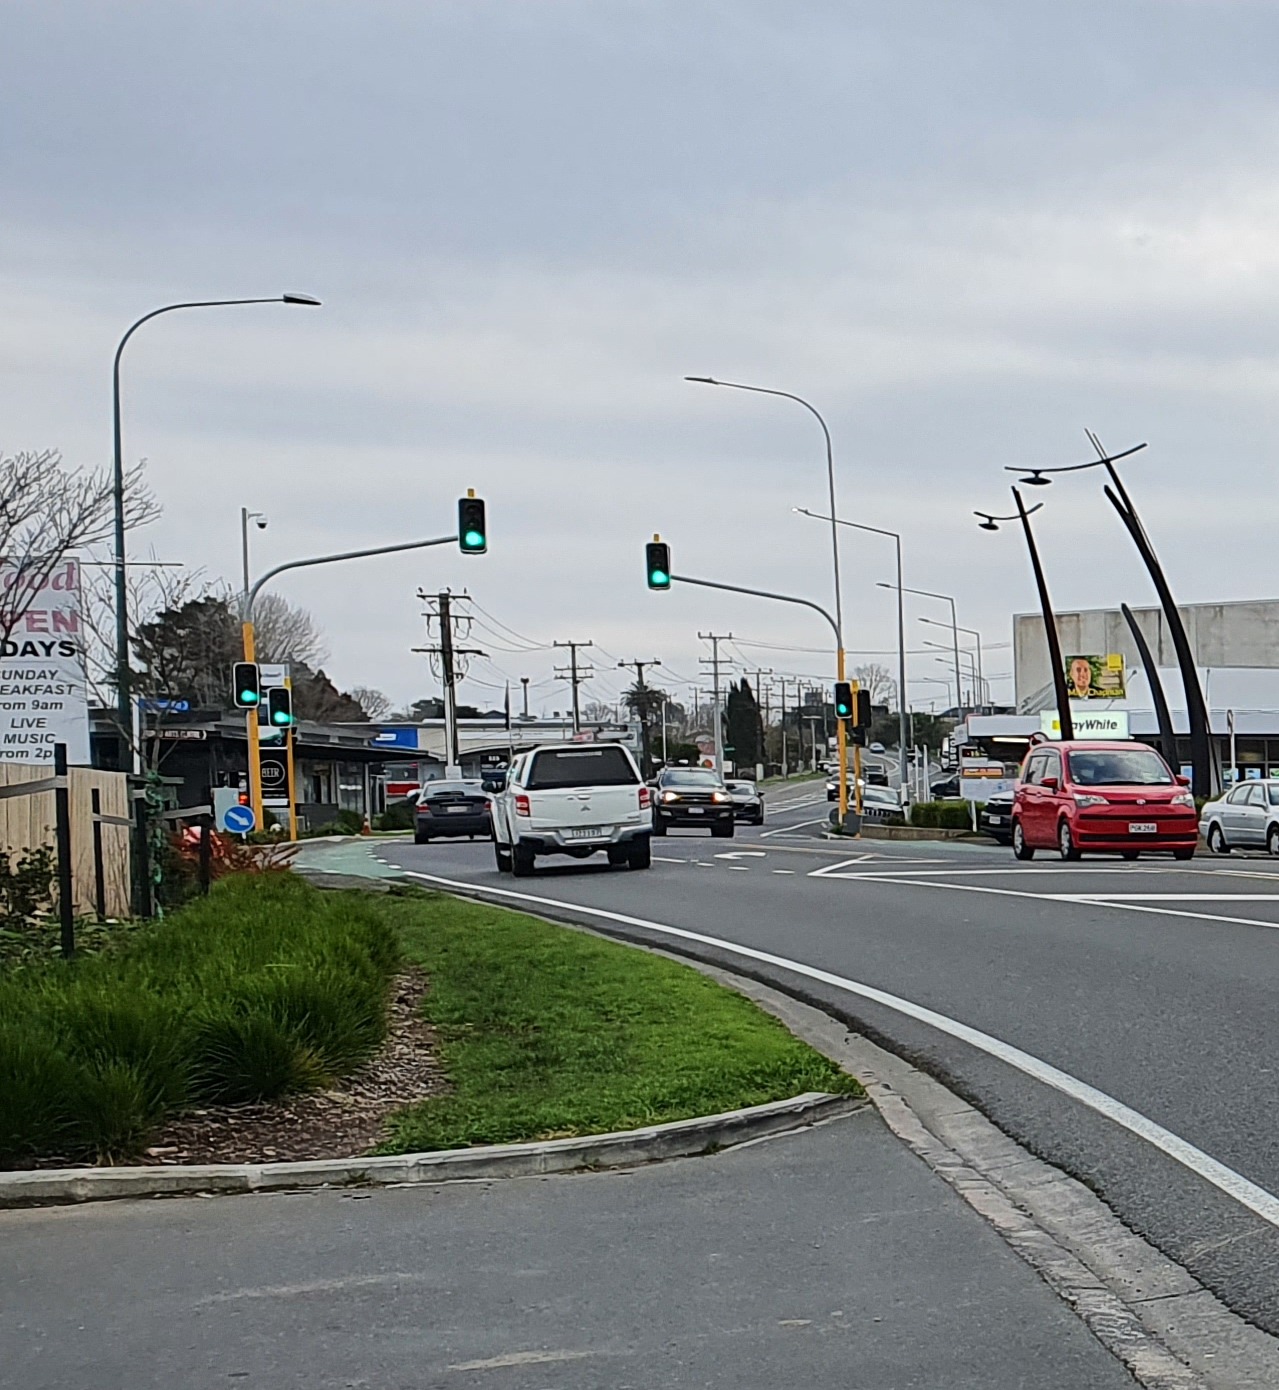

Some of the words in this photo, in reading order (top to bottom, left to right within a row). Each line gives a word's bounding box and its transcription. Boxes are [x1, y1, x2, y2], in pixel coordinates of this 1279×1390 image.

[3, 562, 78, 591] ood
[1, 641, 76, 657] DAYS
[0, 669, 58, 680] UNDAY
[0, 684, 74, 695] EAKFAST
[31, 700, 63, 710] 9am
[11, 718, 47, 728] LIVE
[4, 734, 56, 744] MUSIC
[0, 750, 29, 758] rom
[35, 748, 53, 760] 2p
